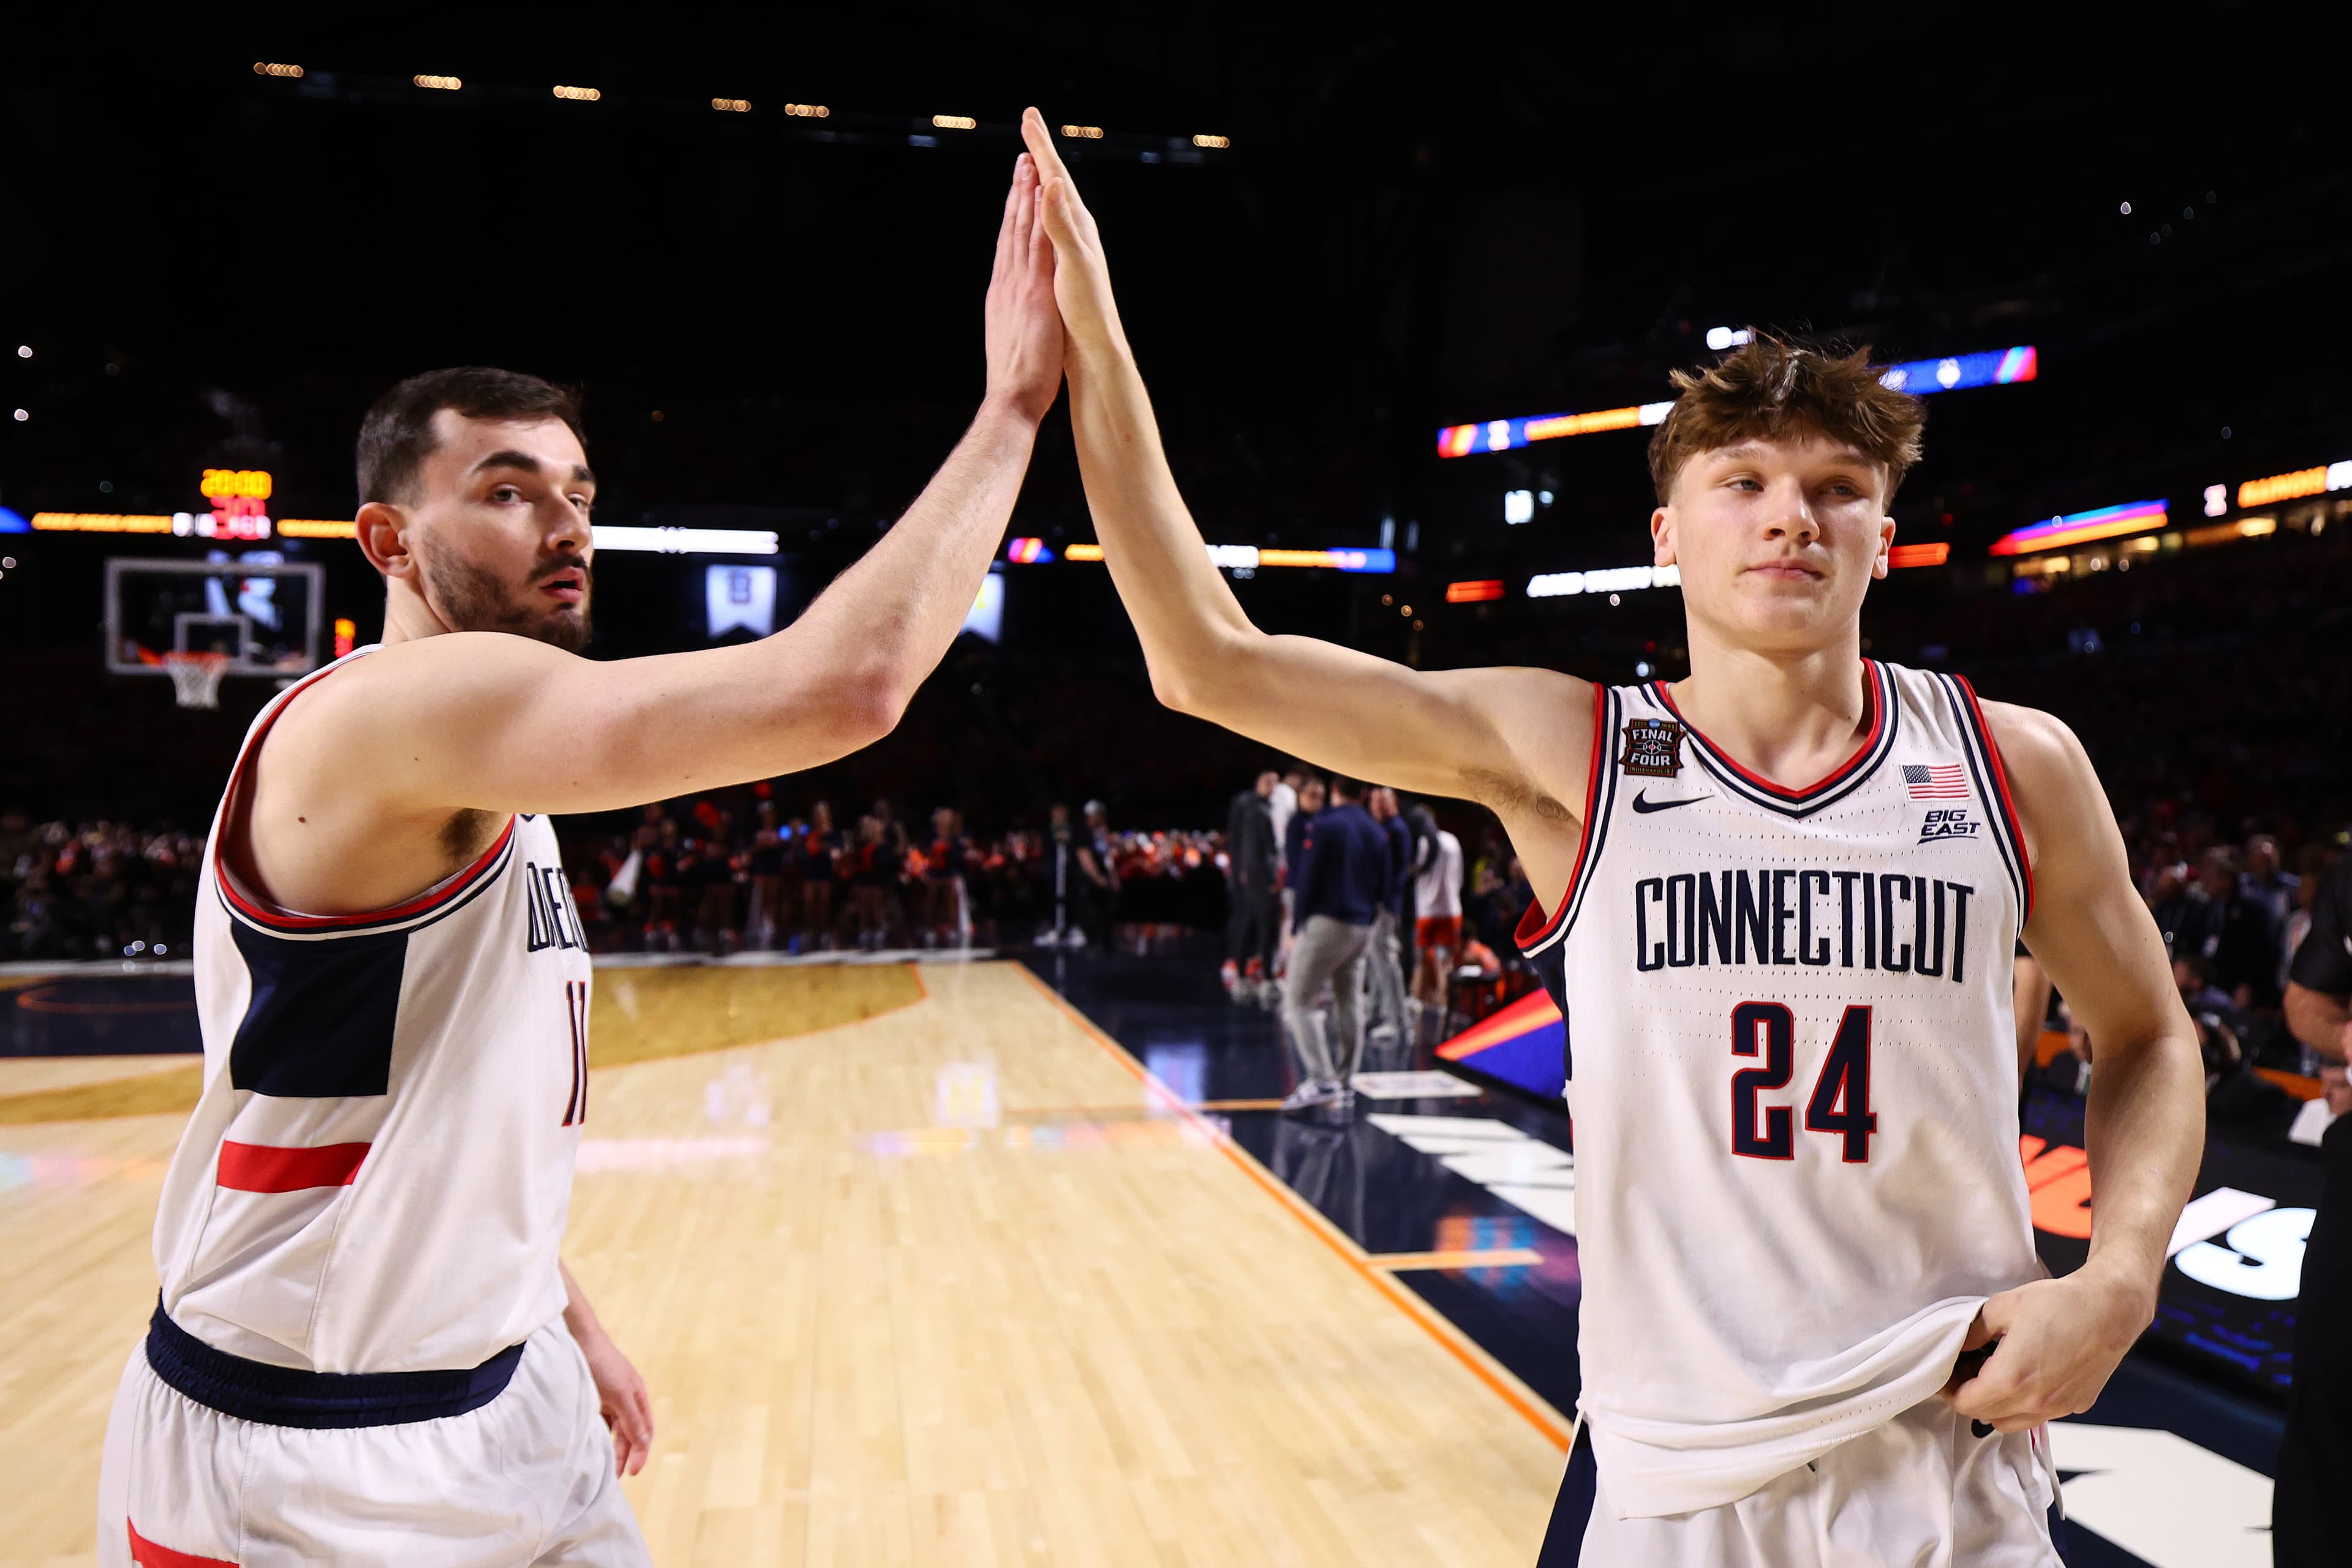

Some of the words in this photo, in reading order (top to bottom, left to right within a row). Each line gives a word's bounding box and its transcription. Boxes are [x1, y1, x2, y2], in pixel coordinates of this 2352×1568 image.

[1632, 728, 1673, 742] FINAL
[1630, 752, 1671, 766] FOUR
[1924, 809, 1967, 823] BIG
[1921, 822, 1981, 836] EAST
[1635, 869, 1975, 984] CONNECTICUT
[1731, 1000, 1877, 1163] 24
